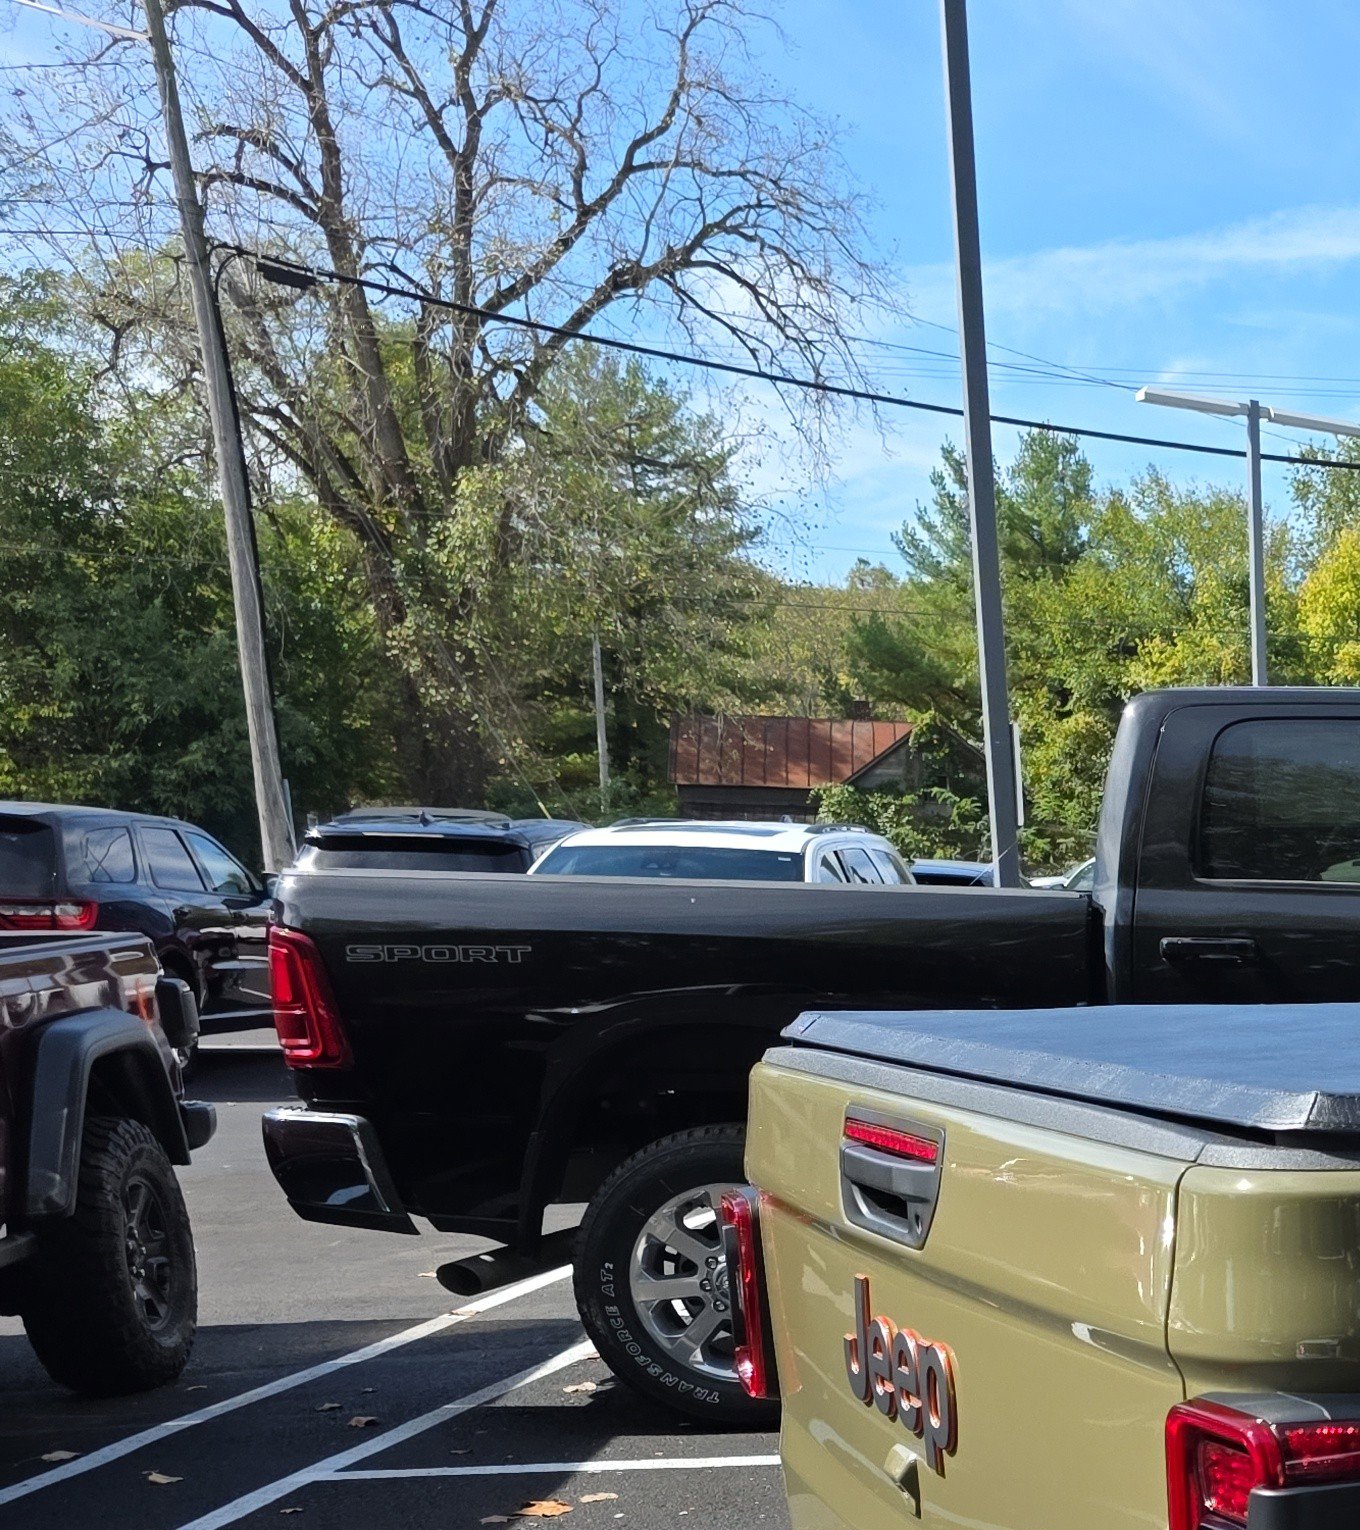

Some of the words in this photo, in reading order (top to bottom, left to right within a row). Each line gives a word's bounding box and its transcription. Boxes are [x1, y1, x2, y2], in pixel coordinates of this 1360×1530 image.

[345, 944, 532, 963] SPORT
[604, 1305, 720, 1403] TRANSFORCE
[843, 1273, 960, 1479] Jeep
